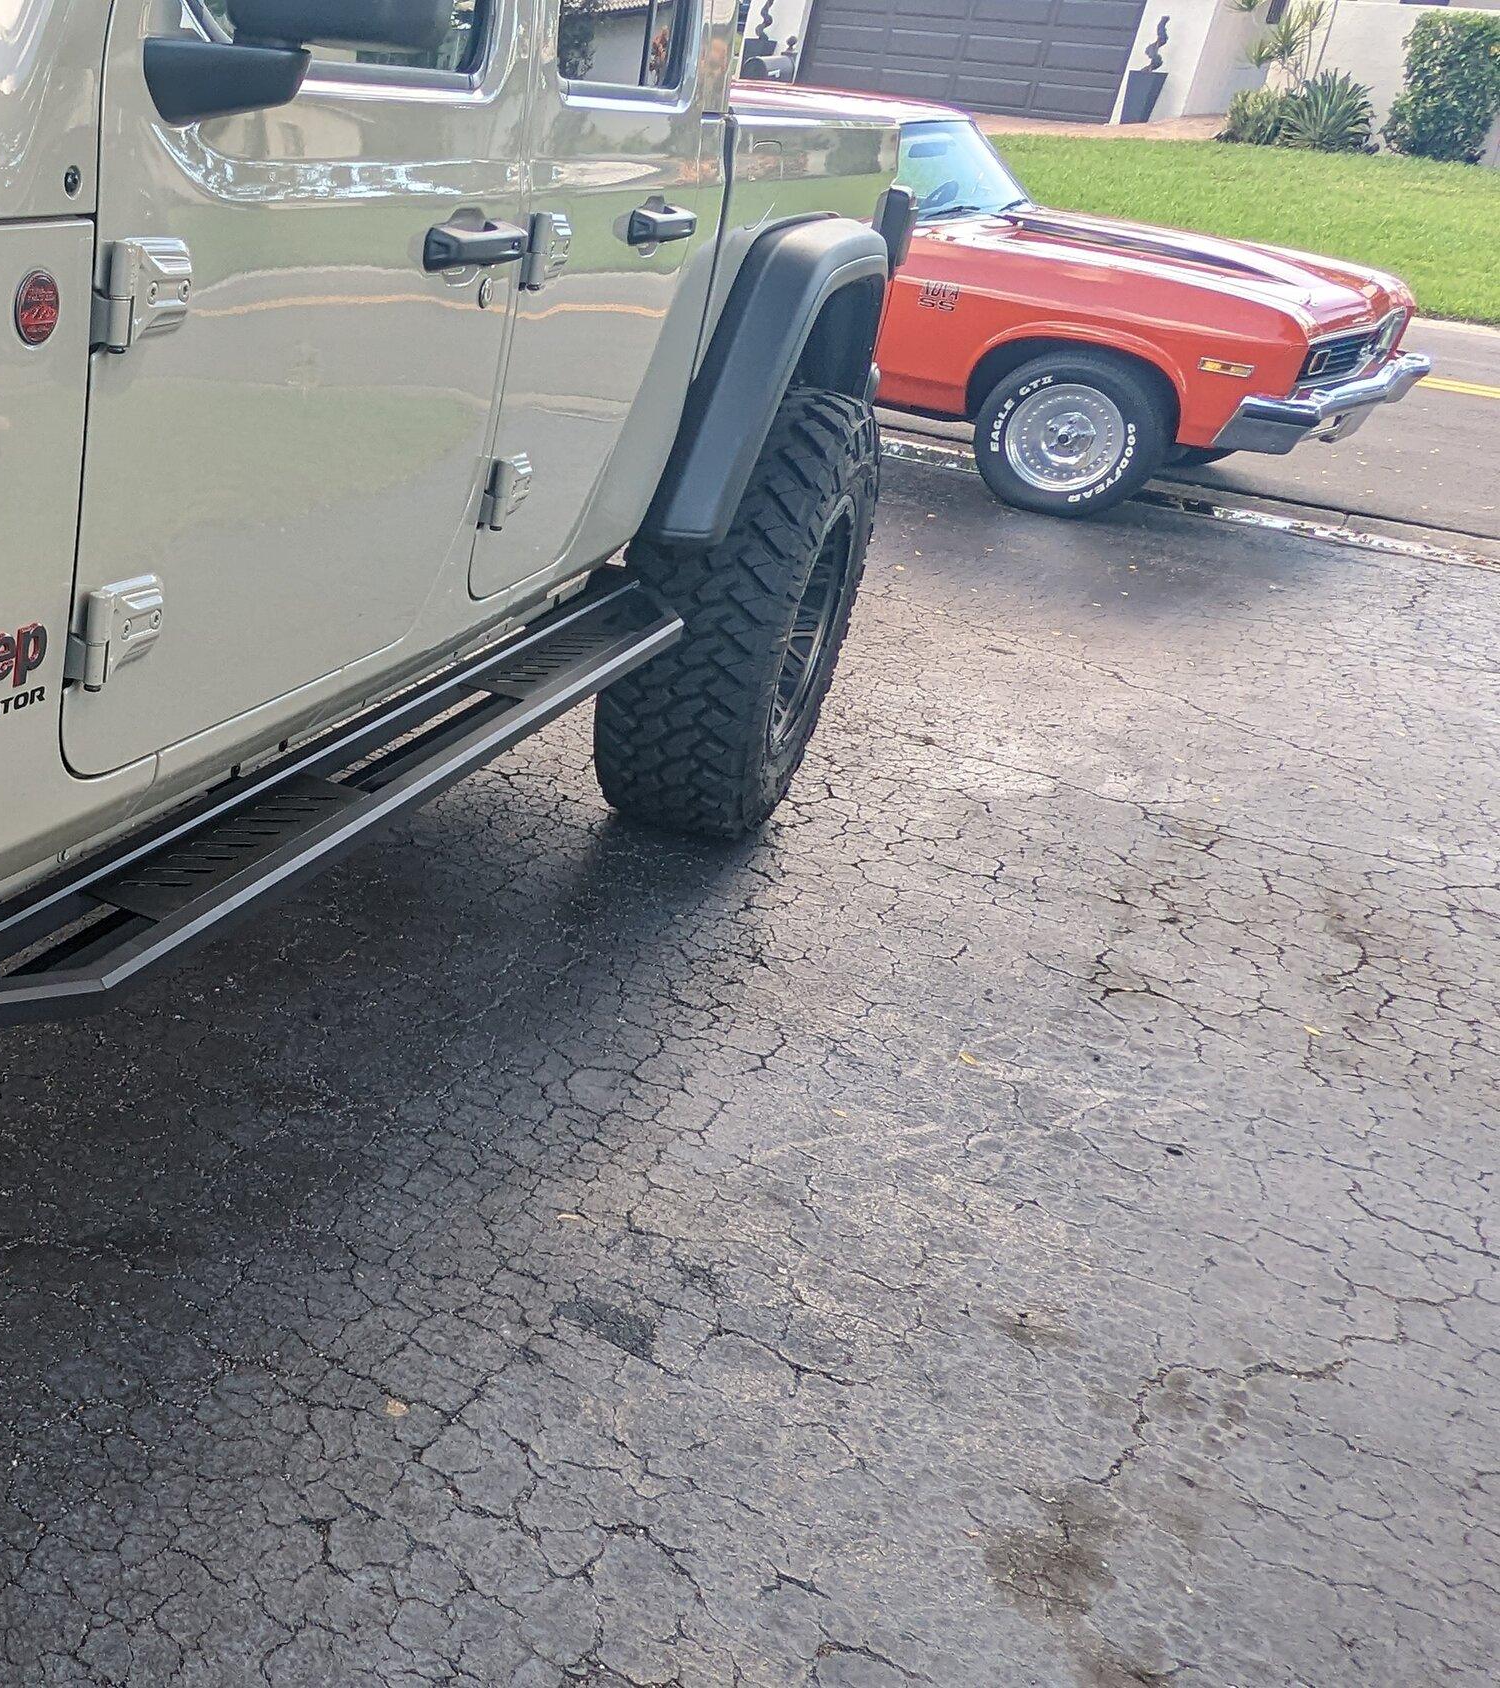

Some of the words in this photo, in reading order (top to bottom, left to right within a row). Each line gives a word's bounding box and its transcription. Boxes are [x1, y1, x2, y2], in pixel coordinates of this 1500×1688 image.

[918, 297, 956, 312] SS
[990, 398, 1015, 452] EAGLE
[1067, 423, 1136, 502] GOODYEAR
